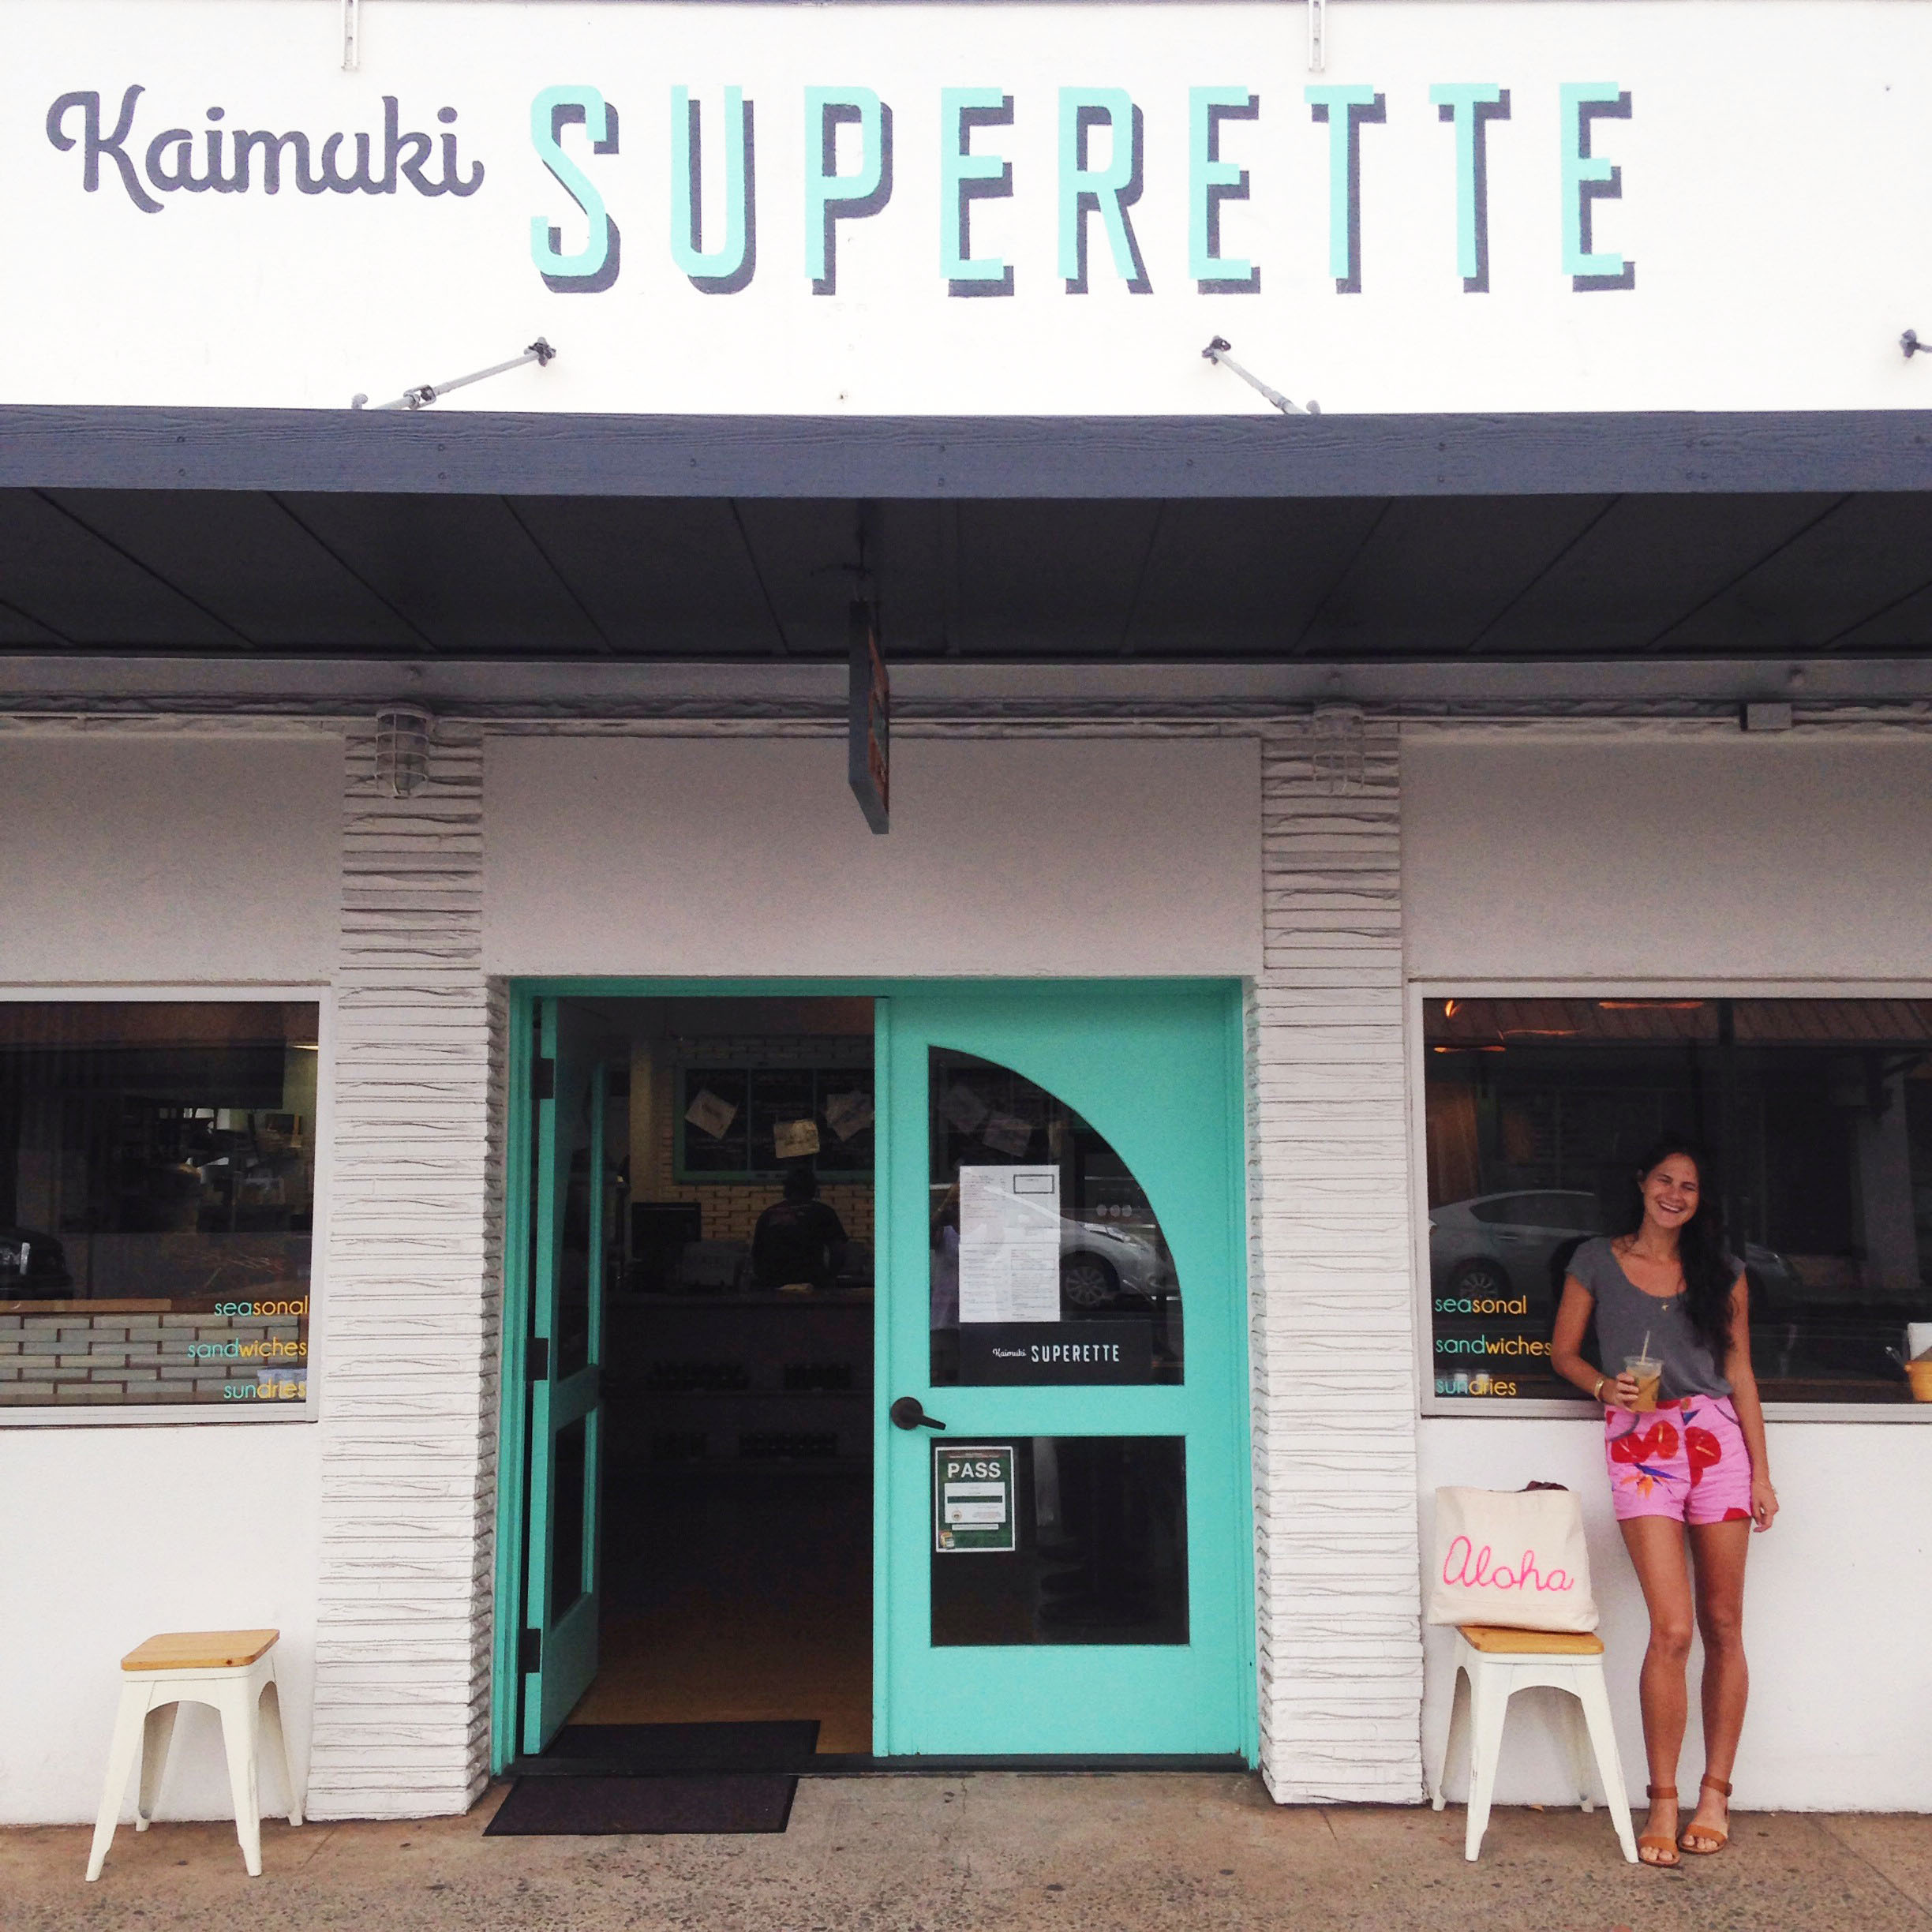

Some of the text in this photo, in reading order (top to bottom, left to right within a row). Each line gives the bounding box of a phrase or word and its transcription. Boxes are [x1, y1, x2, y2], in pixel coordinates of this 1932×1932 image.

[46, 81, 1636, 298] Kaimuki SUPERETTE
[214, 1295, 309, 1316] seasonal
[1435, 1294, 1527, 1315] seasonal
[188, 1336, 307, 1358] sandwiches
[992, 1345, 1120, 1362] Kaimuki SUPERETTE
[1435, 1334, 1552, 1356] sandwiches
[223, 1377, 307, 1399] sundries
[1435, 1376, 1517, 1395] sundries
[947, 1462, 1002, 1479] PASS
[1443, 1535, 1574, 1592] Aloha
